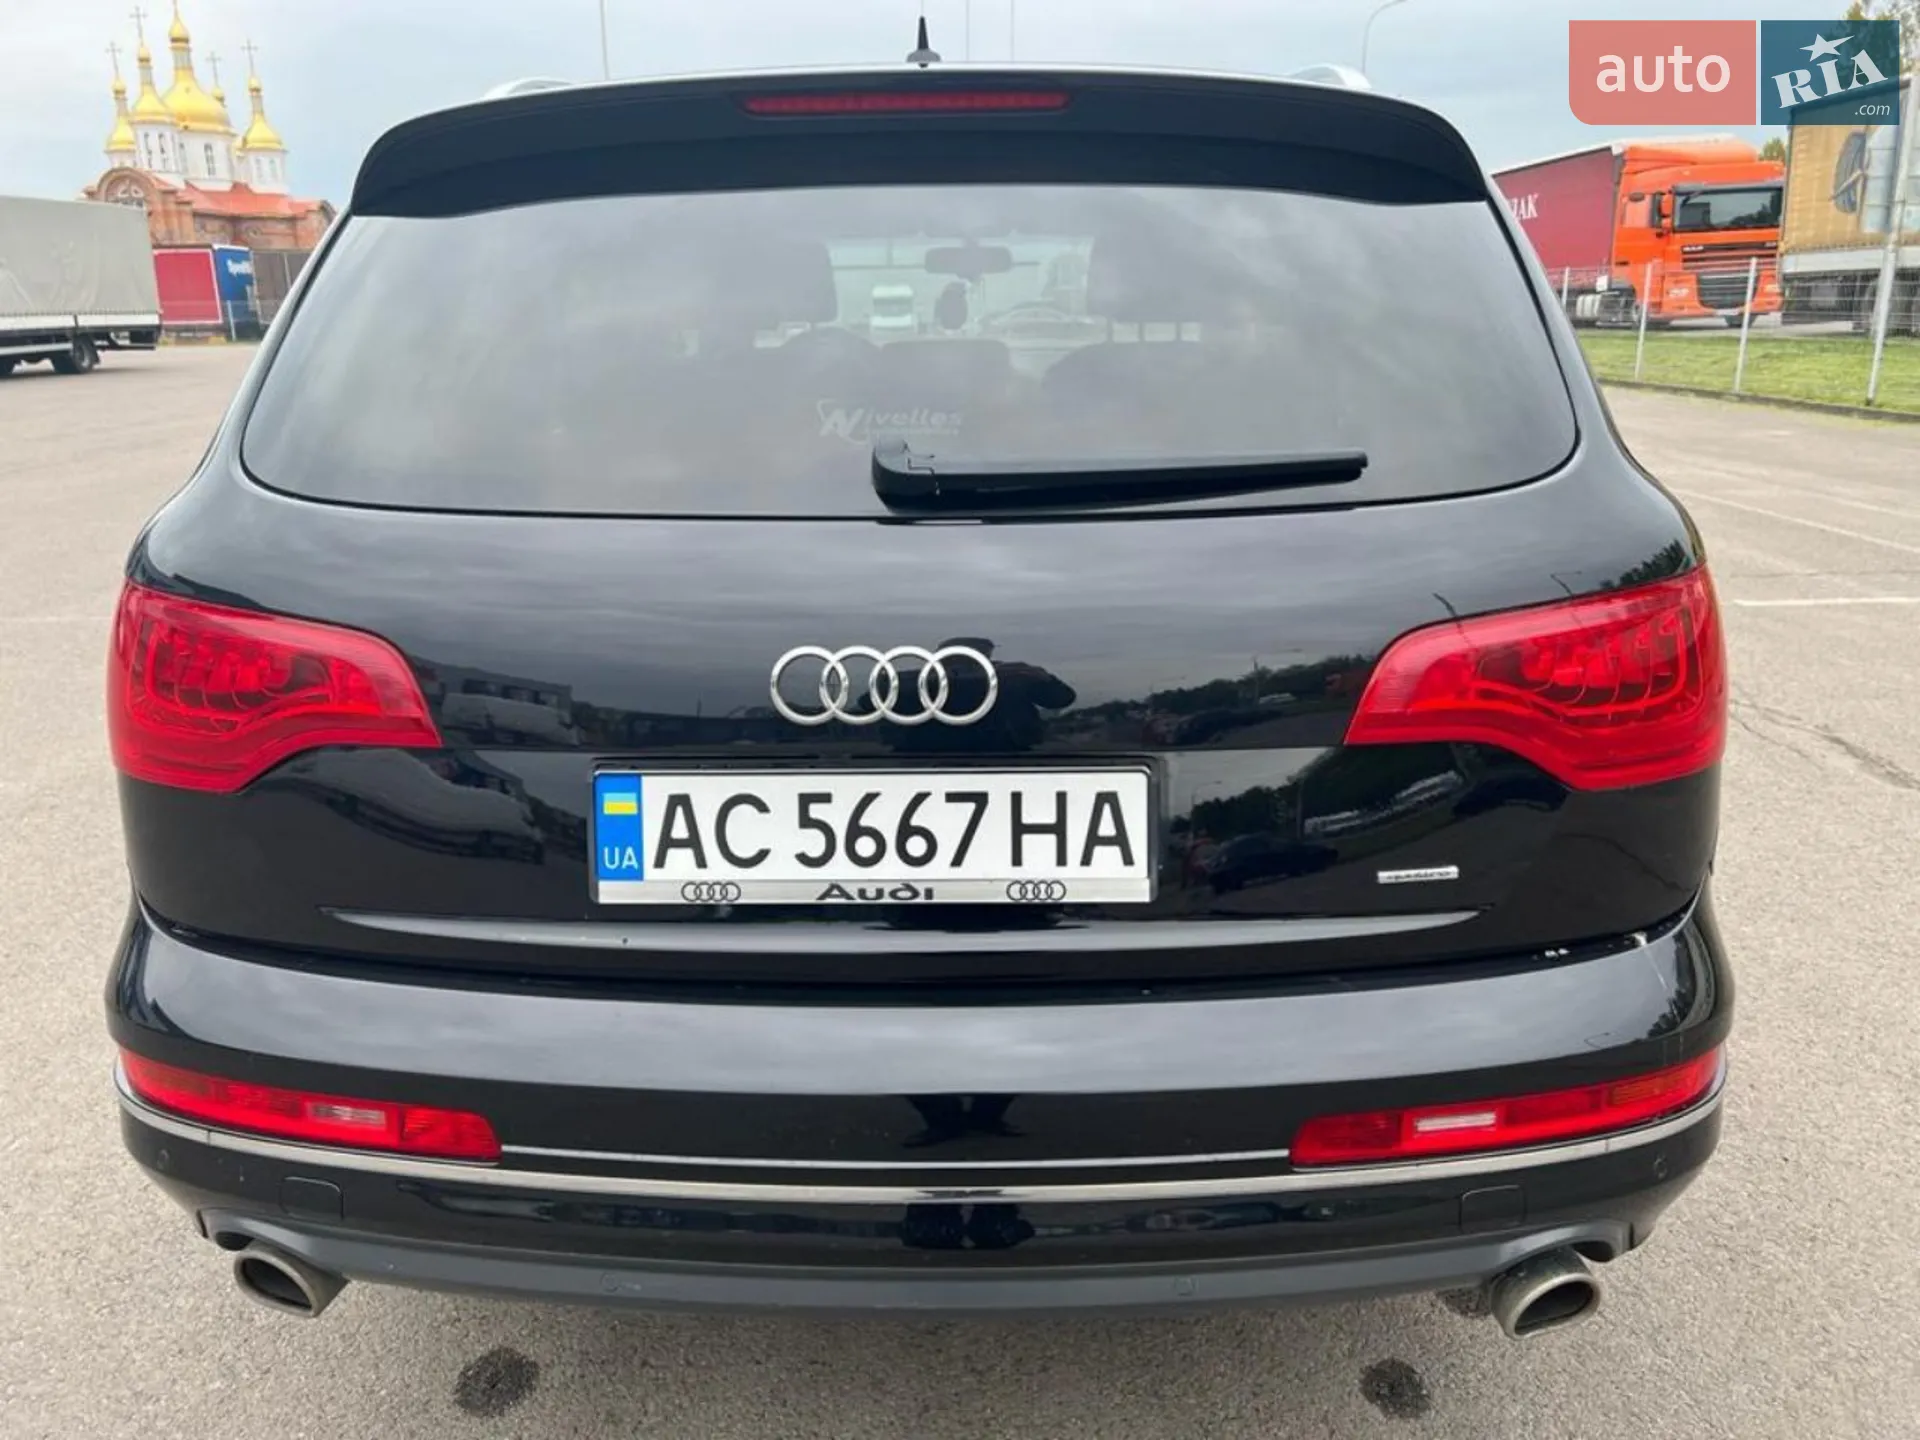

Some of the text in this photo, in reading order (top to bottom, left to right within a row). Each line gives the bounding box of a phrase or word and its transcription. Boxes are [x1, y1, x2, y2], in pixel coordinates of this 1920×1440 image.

[654, 790, 1135, 869] AC 5667 HA
[603, 845, 639, 870] UA
[815, 882, 934, 901] Audi
